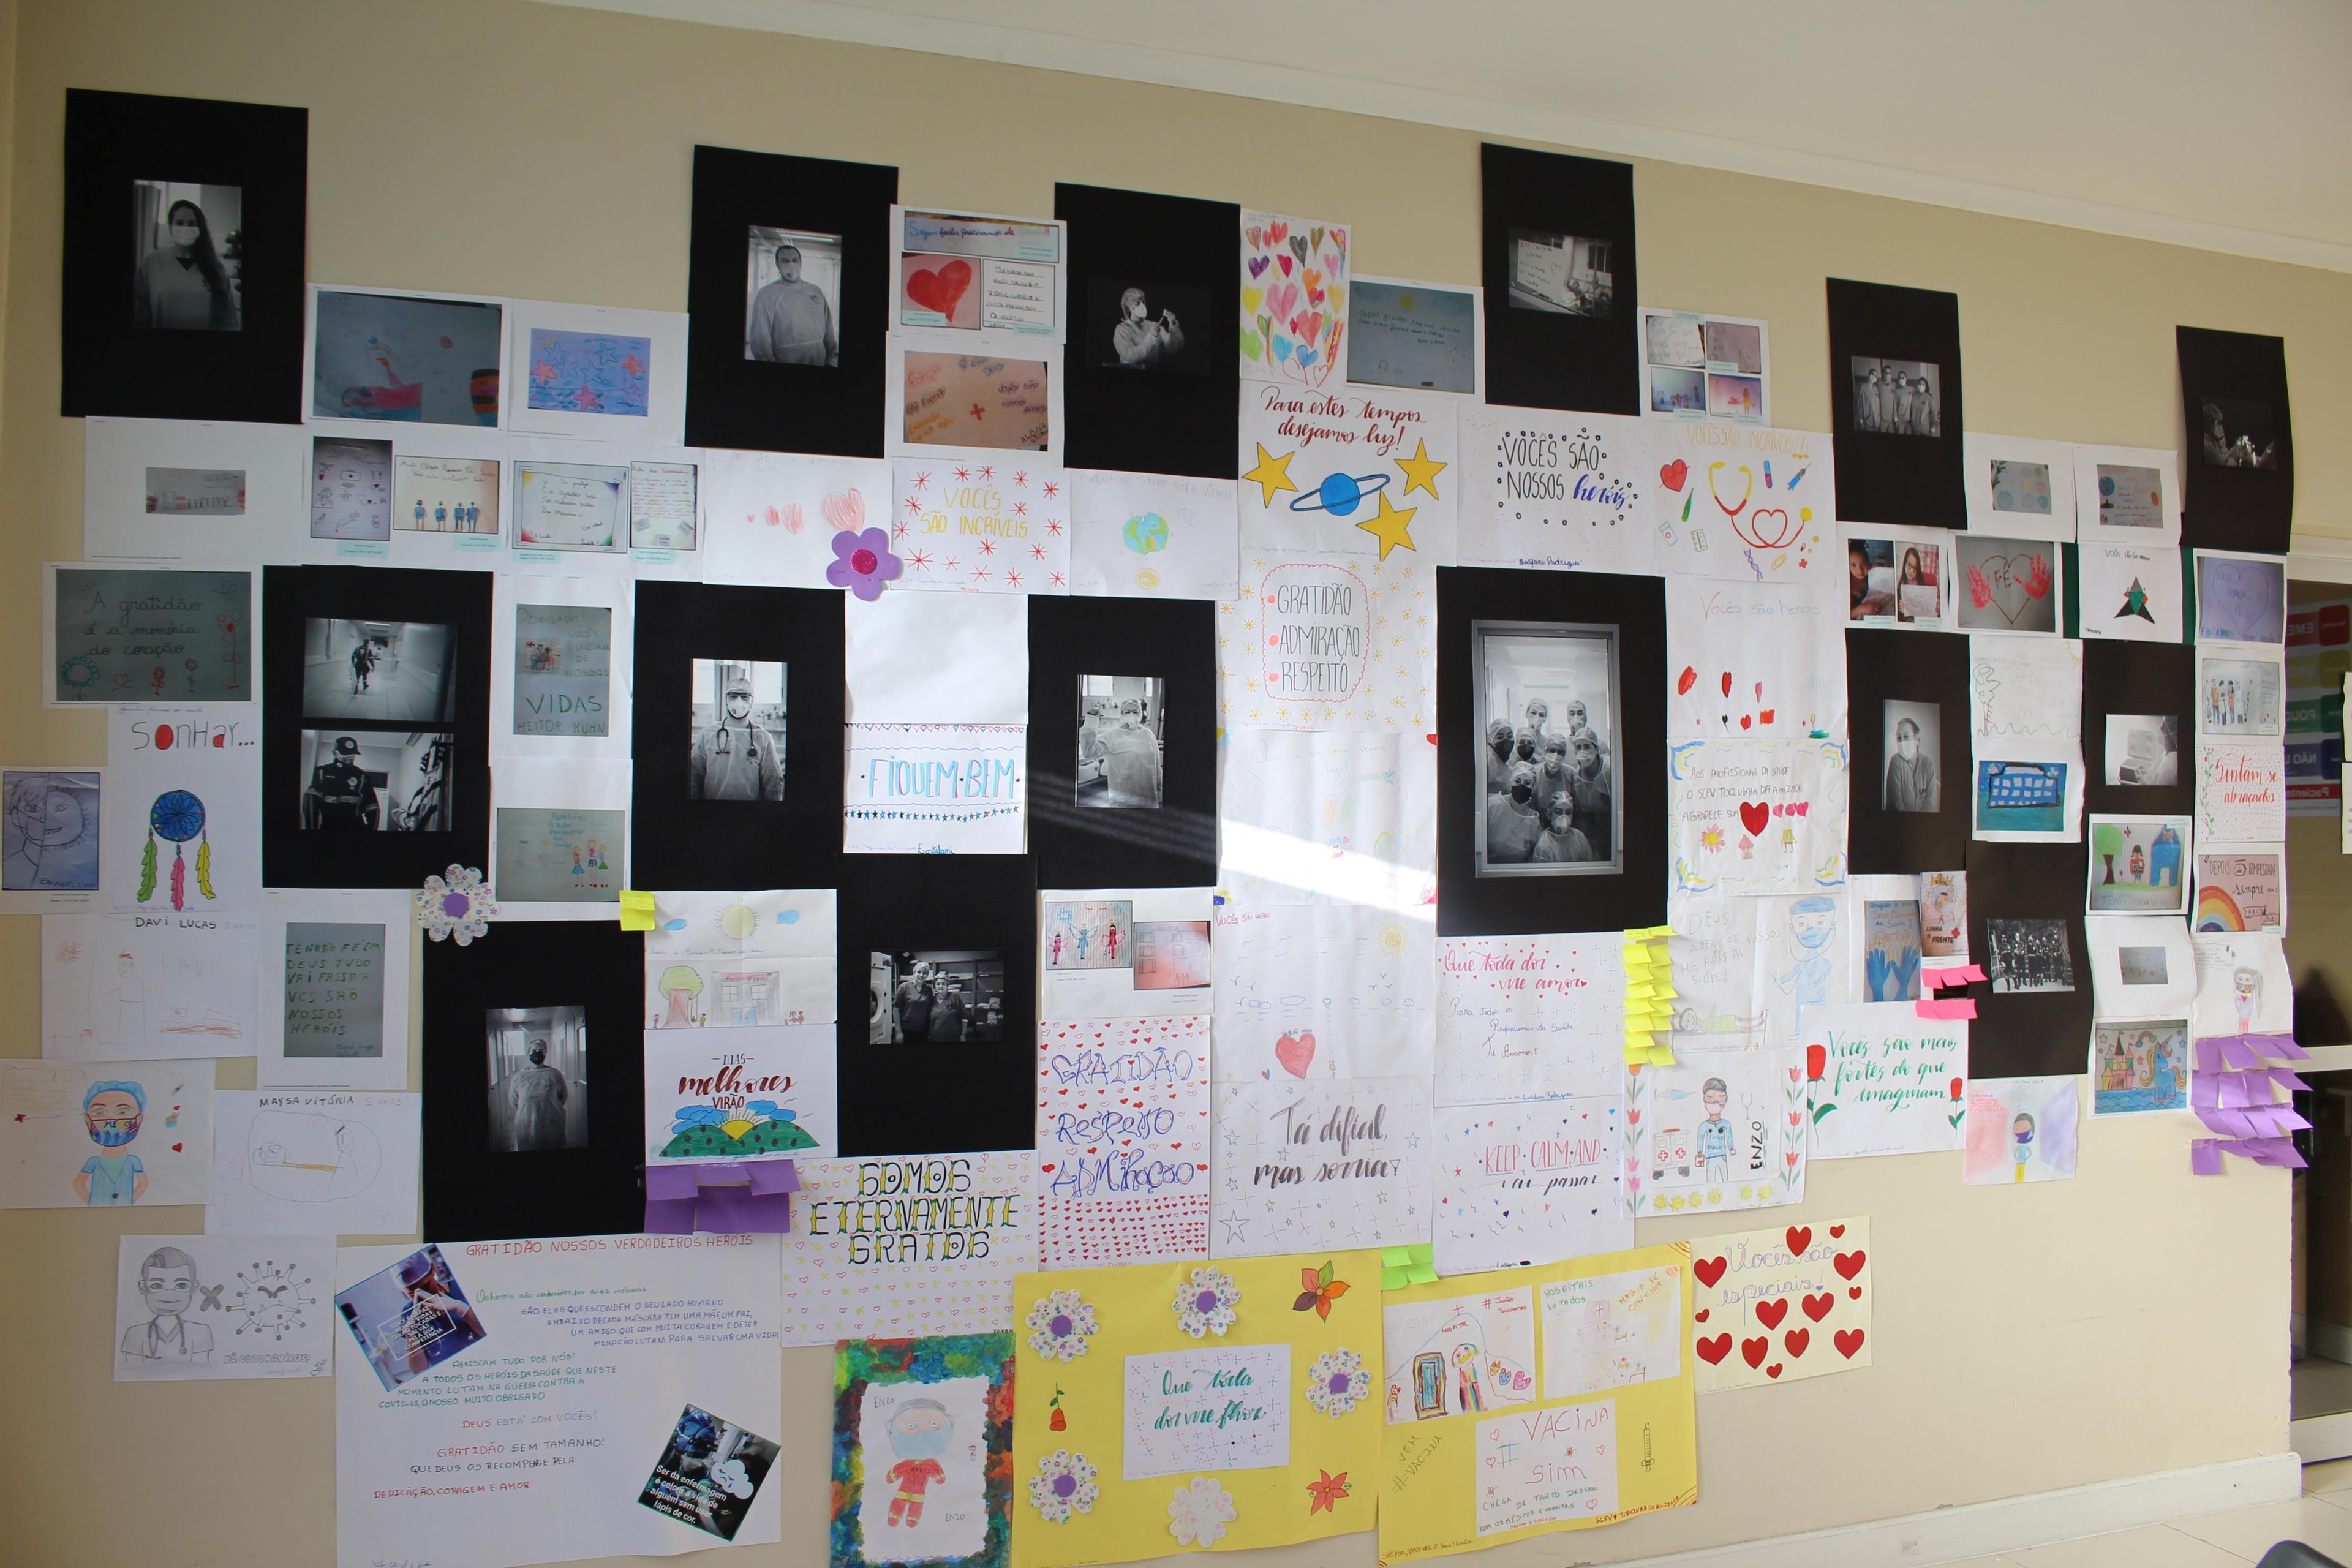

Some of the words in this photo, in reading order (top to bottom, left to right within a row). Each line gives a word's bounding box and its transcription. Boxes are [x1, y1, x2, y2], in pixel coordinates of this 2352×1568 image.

[1261, 386, 1304, 411] Para
[1305, 390, 1349, 418] estes
[1349, 397, 1427, 429] tempos
[1278, 416, 1359, 448] desejamos
[1363, 423, 1406, 456] luz!
[1686, 423, 1721, 446] VOCÊS
[1502, 433, 1557, 467] VOCÊS
[1569, 435, 1599, 470] SÃO
[943, 484, 1001, 510] VOCÊS
[1507, 471, 1564, 500] NOSSOS
[921, 510, 948, 534] SÃO
[960, 511, 1029, 538] INCRÍVEIS
[85, 590, 105, 614] A
[119, 595, 202, 627] gratidão
[1277, 583, 1351, 615] GRATIDÃO
[1700, 590, 1741, 624] Vocês
[1752, 604, 1773, 614] são
[106, 625, 121, 635] a
[130, 624, 199, 636] memória
[85, 644, 111, 656] do
[124, 644, 185, 657] coração
[1279, 623, 1360, 662] ADMIRAÇÃO
[1281, 660, 1348, 692] RESPEITO
[525, 694, 603, 714] VIDAS
[965, 759, 1014, 799] BEM
[2224, 786, 2275, 809] abraçados
[2209, 860, 2230, 875] DEPOIS
[179, 918, 216, 929] LUCAS
[1690, 911, 1728, 935] DEUS
[1445, 949, 1475, 971] Que
[1469, 951, 1514, 971] toda
[1521, 952, 1547, 970] dor
[1733, 949, 1743, 959] DA
[288, 1009, 342, 1019] NOSSOS
[1828, 1030, 1872, 1058] Vocês
[1882, 1035, 1913, 1057] são
[723, 1052, 745, 1065] DIAS
[679, 1065, 798, 1095] melhores
[1834, 1060, 1885, 1096] fortes
[1893, 1058, 1911, 1076] do
[1918, 1062, 1948, 1085] que
[260, 1096, 299, 1107] MAYSA
[712, 1093, 744, 1109] VIRÃO
[1485, 1144, 1520, 1174] KEEP
[1531, 1140, 1569, 1169] CALM
[1572, 1139, 1600, 1164] AND
[1751, 1121, 1763, 1169] ENZO
[858, 1159, 971, 1197] SOMOS
[1254, 1164, 1306, 1189] mas
[810, 1194, 1020, 1235] ETERNAMENTE
[466, 1240, 542, 1256] GRATIDÃO
[551, 1240, 606, 1252] NOSSOS
[614, 1237, 701, 1250] VERDADEIROS
[706, 1234, 753, 1247] HERÓIS
[848, 1231, 989, 1264] GRATOS
[1725, 1239, 1796, 1272] Vocês
[619, 1325, 634, 1335] QUE
[685, 1321, 723, 1330] CORAGEM
[485, 1369, 518, 1379] HERÓIS
[533, 1368, 560, 1376] SAÚDE
[586, 1366, 617, 1374] NESTE
[1163, 1370, 1193, 1395] Que
[1193, 1367, 1254, 1390] toda
[447, 1384, 484, 1393] LUTAM
[538, 1378, 575, 1387] CONTRA
[465, 1395, 492, 1404] MUITO
[496, 1392, 545, 1402] OBRIGADO
[874, 1396, 894, 1408] ENZO
[462, 1419, 491, 1428] DEUS
[1154, 1406, 1181, 1429] dor
[1521, 1408, 1608, 1443] VACINA
[437, 1441, 504, 1458] GRATIDÃO
[511, 1443, 538, 1452] SEM
[1398, 1436, 1420, 1463] VEM
[410, 1464, 432, 1474] QUE
[552, 1457, 575, 1465] PELA
[437, 1485, 485, 1494] CORAGEM
[500, 1482, 529, 1490] AMOR
[657, 1465, 670, 1476] Ser
[670, 1472, 679, 1480] da
[680, 1477, 727, 1501] enfermagem
[650, 1488, 678, 1503] alguém
[679, 1499, 695, 1510] sem
[696, 1507, 712, 1518] usar
[692, 1493, 707, 1503] vida
[708, 1499, 718, 1509] de
[1483, 1498, 1511, 1511] CHEGA
[1516, 1501, 1525, 1510] DE
[1533, 1492, 1560, 1502] TANTO
[1566, 1487, 1597, 1497] DESCASO
[654, 1500, 672, 1513] lápis
[673, 1507, 682, 1518] de
[683, 1514, 696, 1523] cor.
[1506, 1510, 1534, 1525] MÉDICOS
